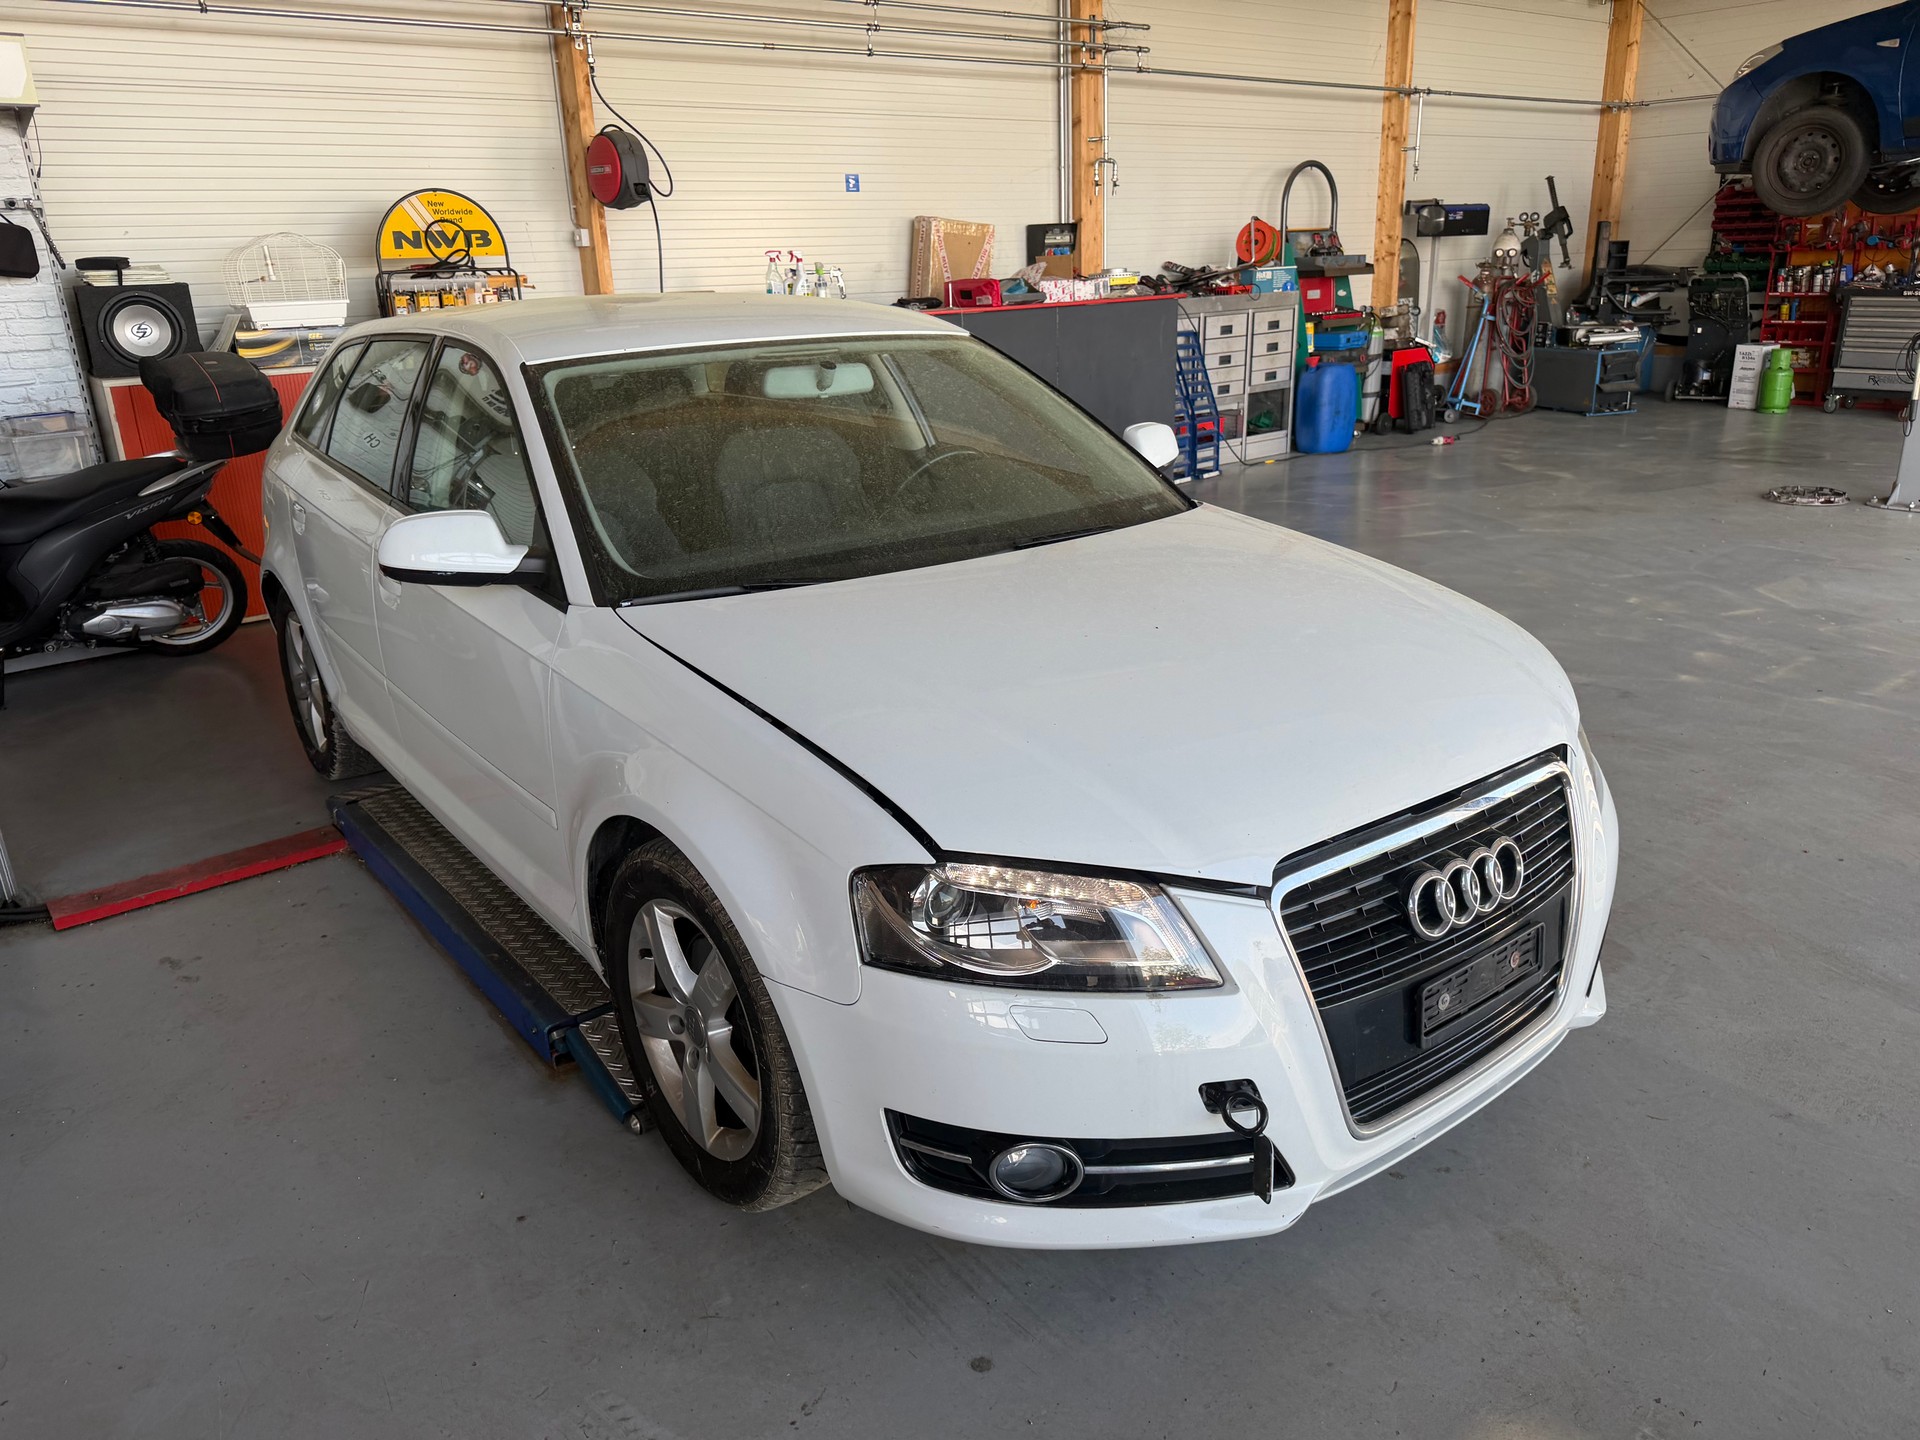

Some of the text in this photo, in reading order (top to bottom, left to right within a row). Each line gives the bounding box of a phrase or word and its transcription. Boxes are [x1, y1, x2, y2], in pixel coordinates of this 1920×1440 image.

[427, 200, 445, 208] New
[431, 208, 473, 216] Worldwide
[440, 216, 463, 224] Band
[392, 229, 493, 250] NWB
[124, 494, 175, 520] VISION
